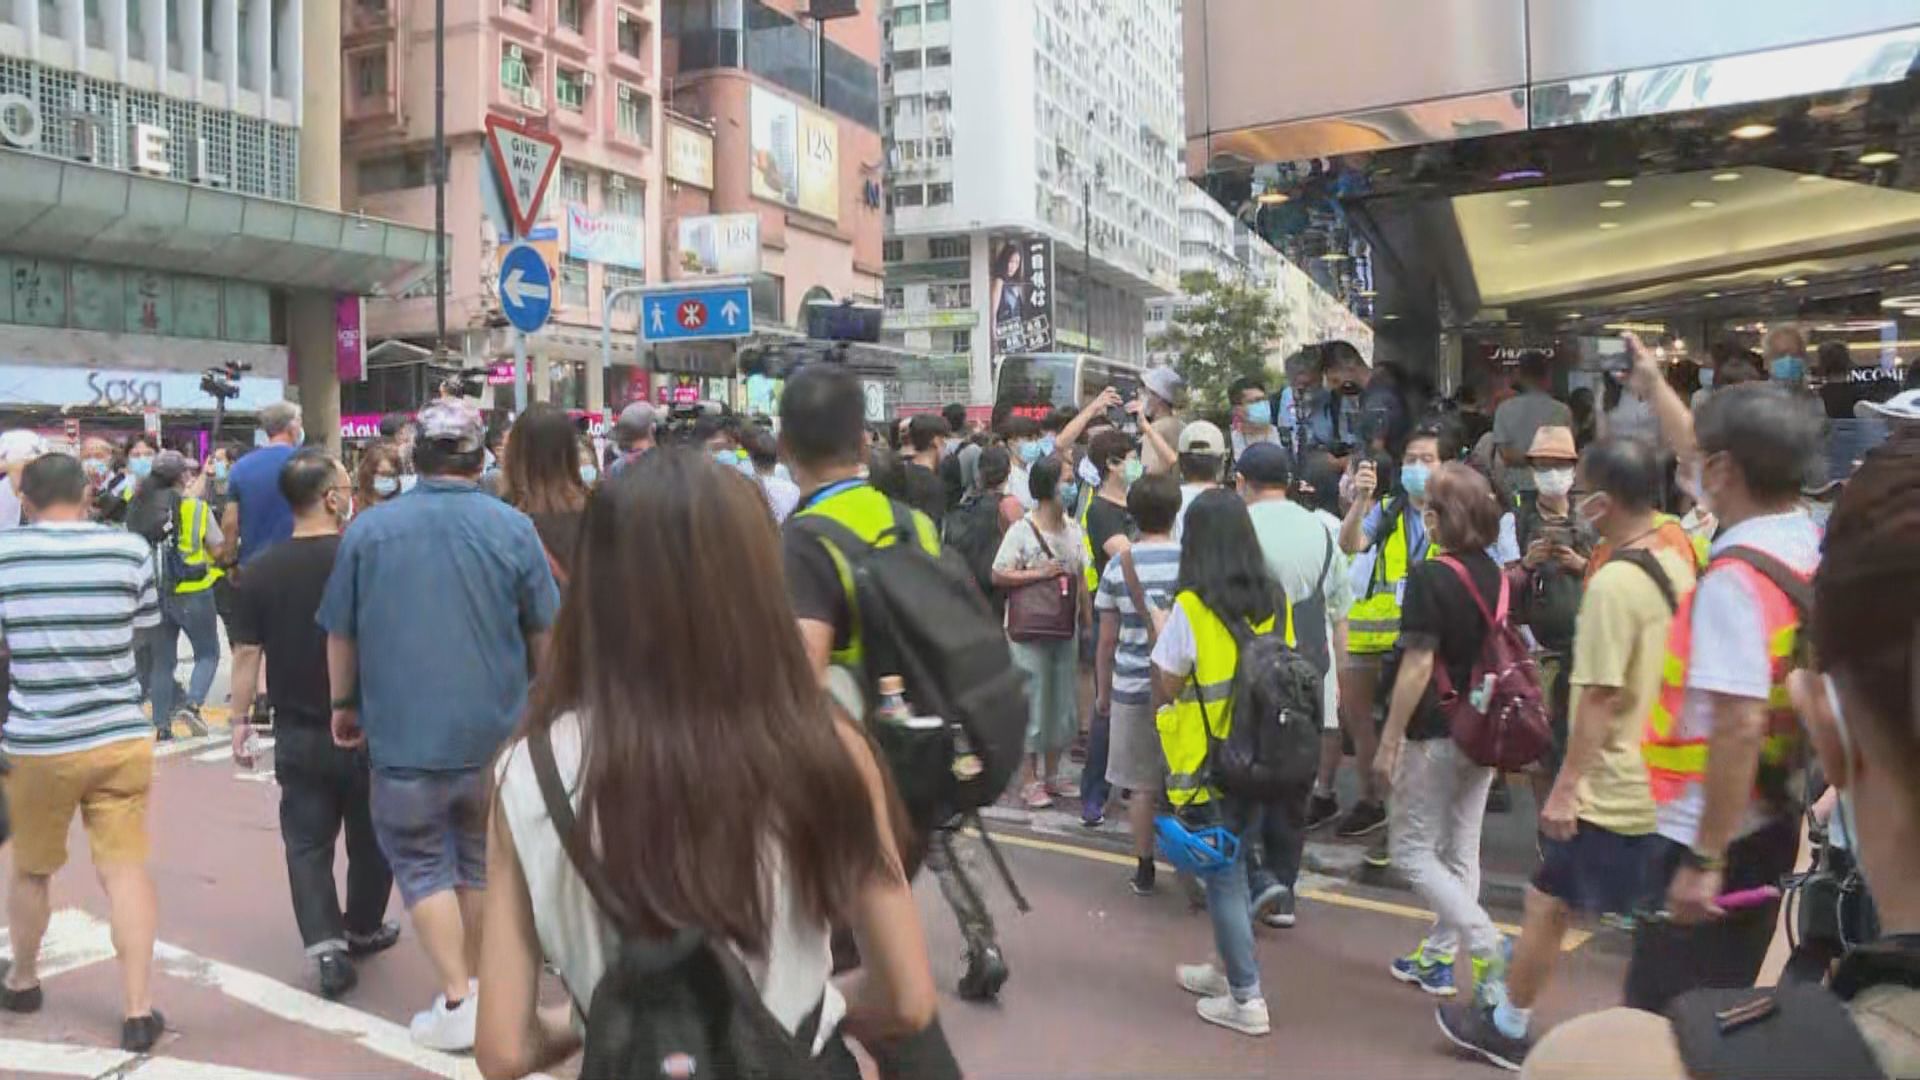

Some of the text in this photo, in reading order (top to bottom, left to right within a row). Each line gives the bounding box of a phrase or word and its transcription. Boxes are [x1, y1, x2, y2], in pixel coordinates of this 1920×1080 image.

[511, 137, 537, 157] GIVE
[806, 126, 833, 161] 128
[512, 154, 537, 173] WAY
